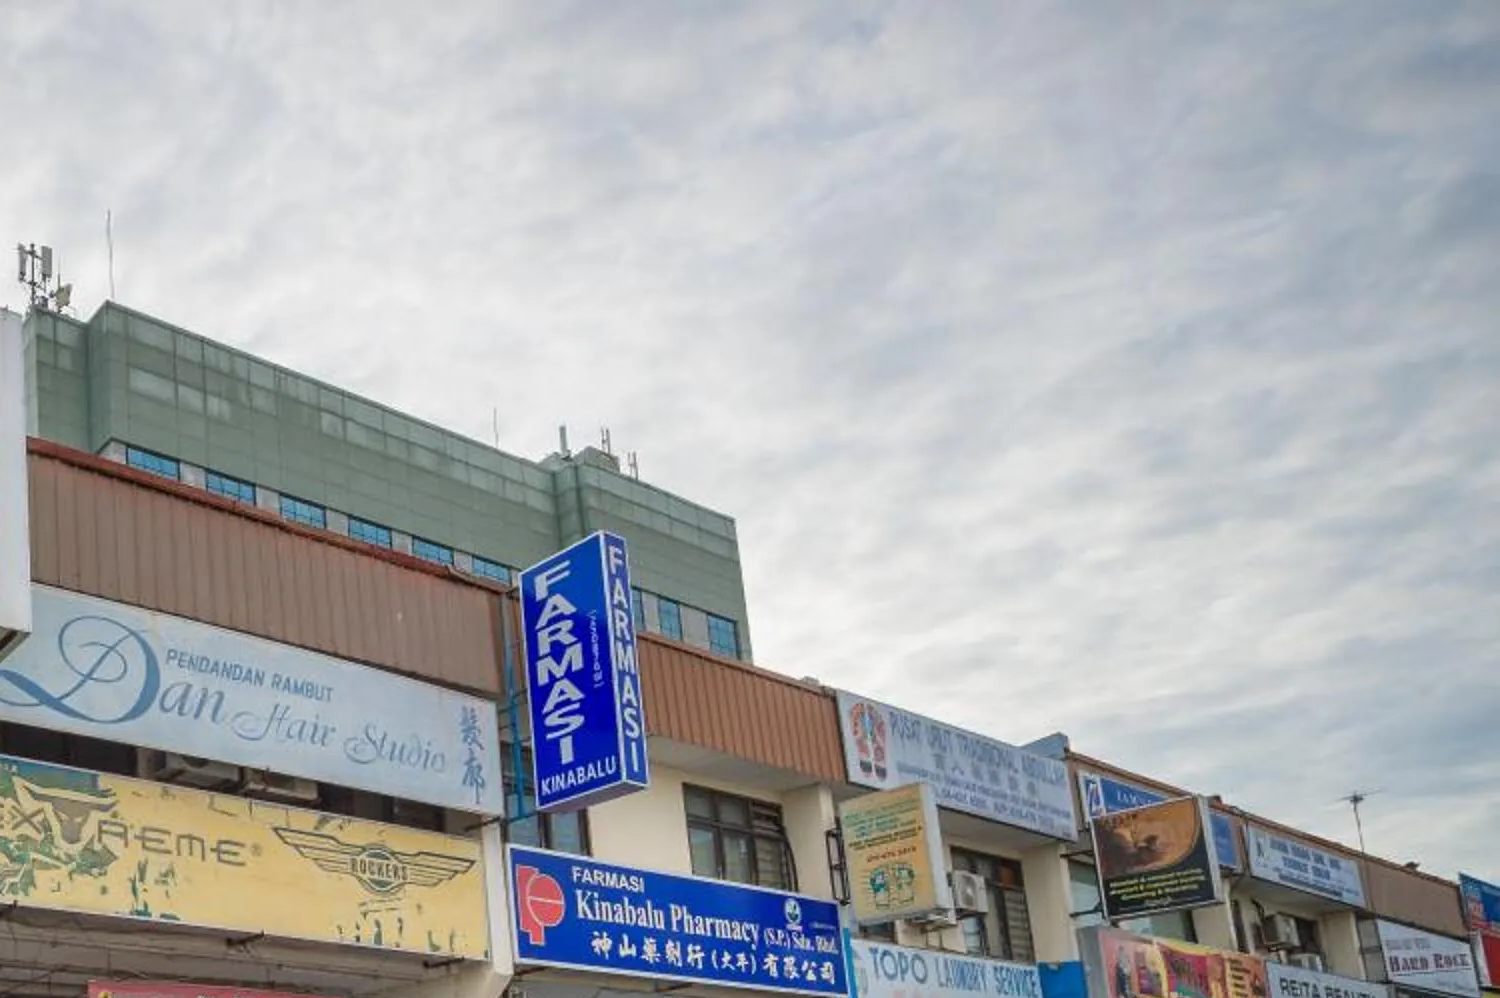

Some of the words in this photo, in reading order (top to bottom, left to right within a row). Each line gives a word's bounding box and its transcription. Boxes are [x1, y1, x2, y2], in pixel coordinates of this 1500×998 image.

[166, 648, 265, 687] PENDANDAN
[271, 672, 334, 702] RAMBUT
[534, 560, 585, 765] FARMASI
[609, 545, 640, 773] FARMASI
[232, 700, 338, 750] Hair
[343, 721, 446, 774] Studio
[541, 755, 617, 796] KINABALU
[350, 858, 409, 881] ROCKERS
[571, 866, 646, 893] FARMASI
[574, 888, 666, 931] Kinabalu
[670, 903, 760, 950] Pharmacy
[868, 946, 929, 985] TOPO
[934, 957, 991, 993] LAUNDRY
[993, 965, 1039, 998] SERVICE
